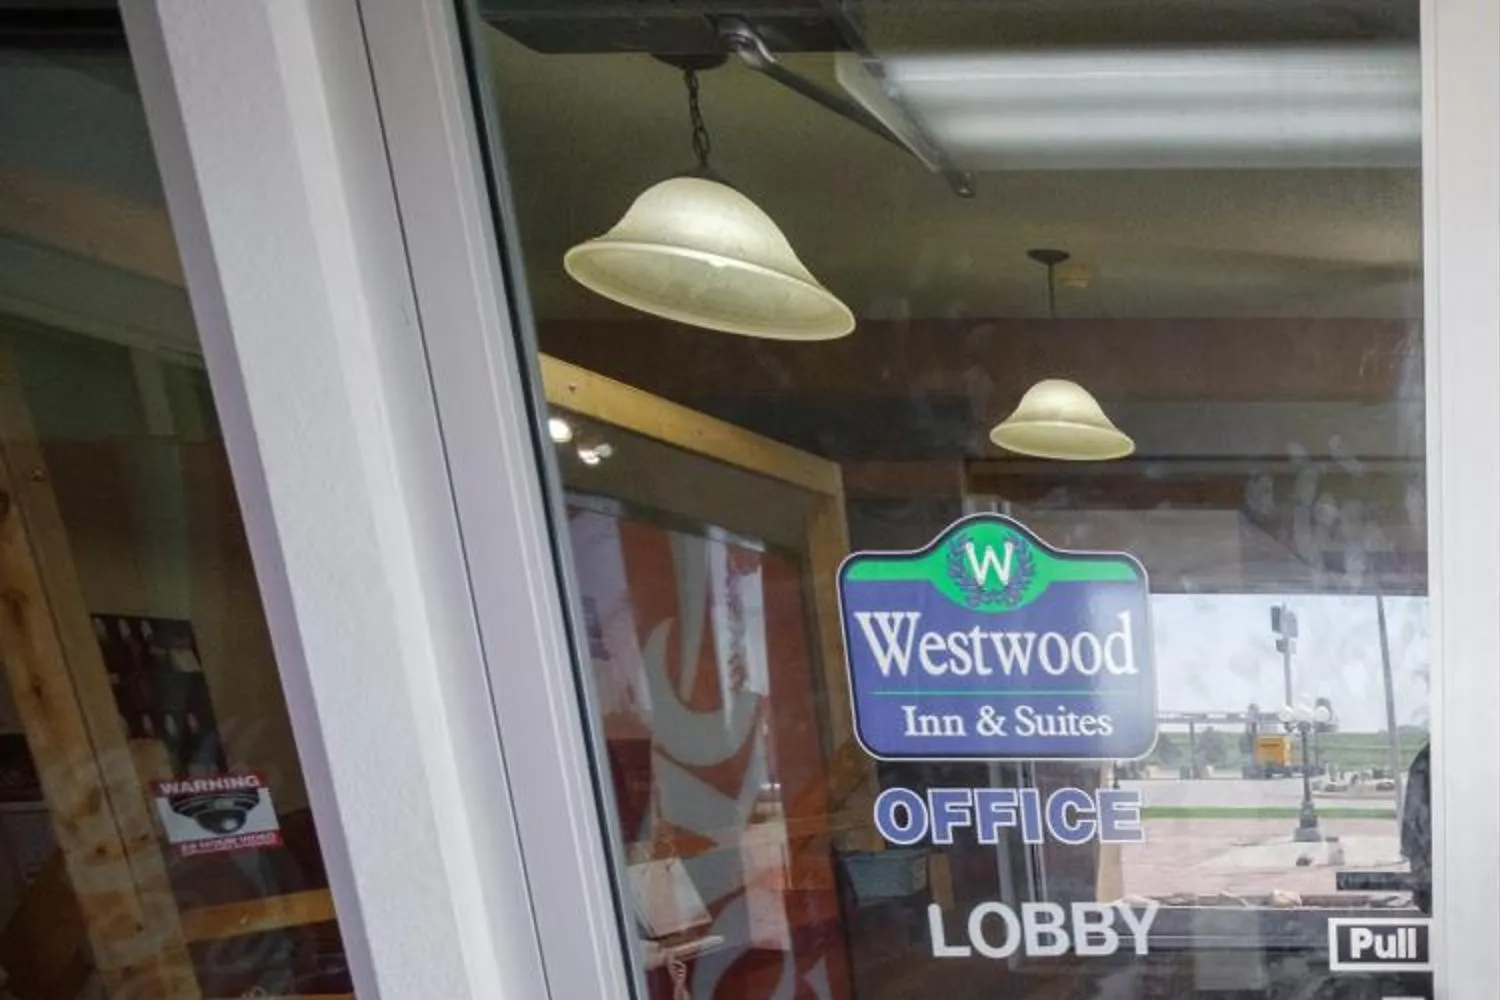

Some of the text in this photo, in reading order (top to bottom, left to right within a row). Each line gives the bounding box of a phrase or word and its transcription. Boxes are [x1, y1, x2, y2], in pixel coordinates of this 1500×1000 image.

[964, 542, 1013, 585] W
[854, 610, 1138, 678] Westwood
[902, 704, 1114, 737] Inn & Suites
[160, 775, 260, 795] WARNING
[873, 787, 1146, 846] OFFICE
[927, 900, 1160, 958] LOBBY
[1350, 928, 1418, 959] Pull
